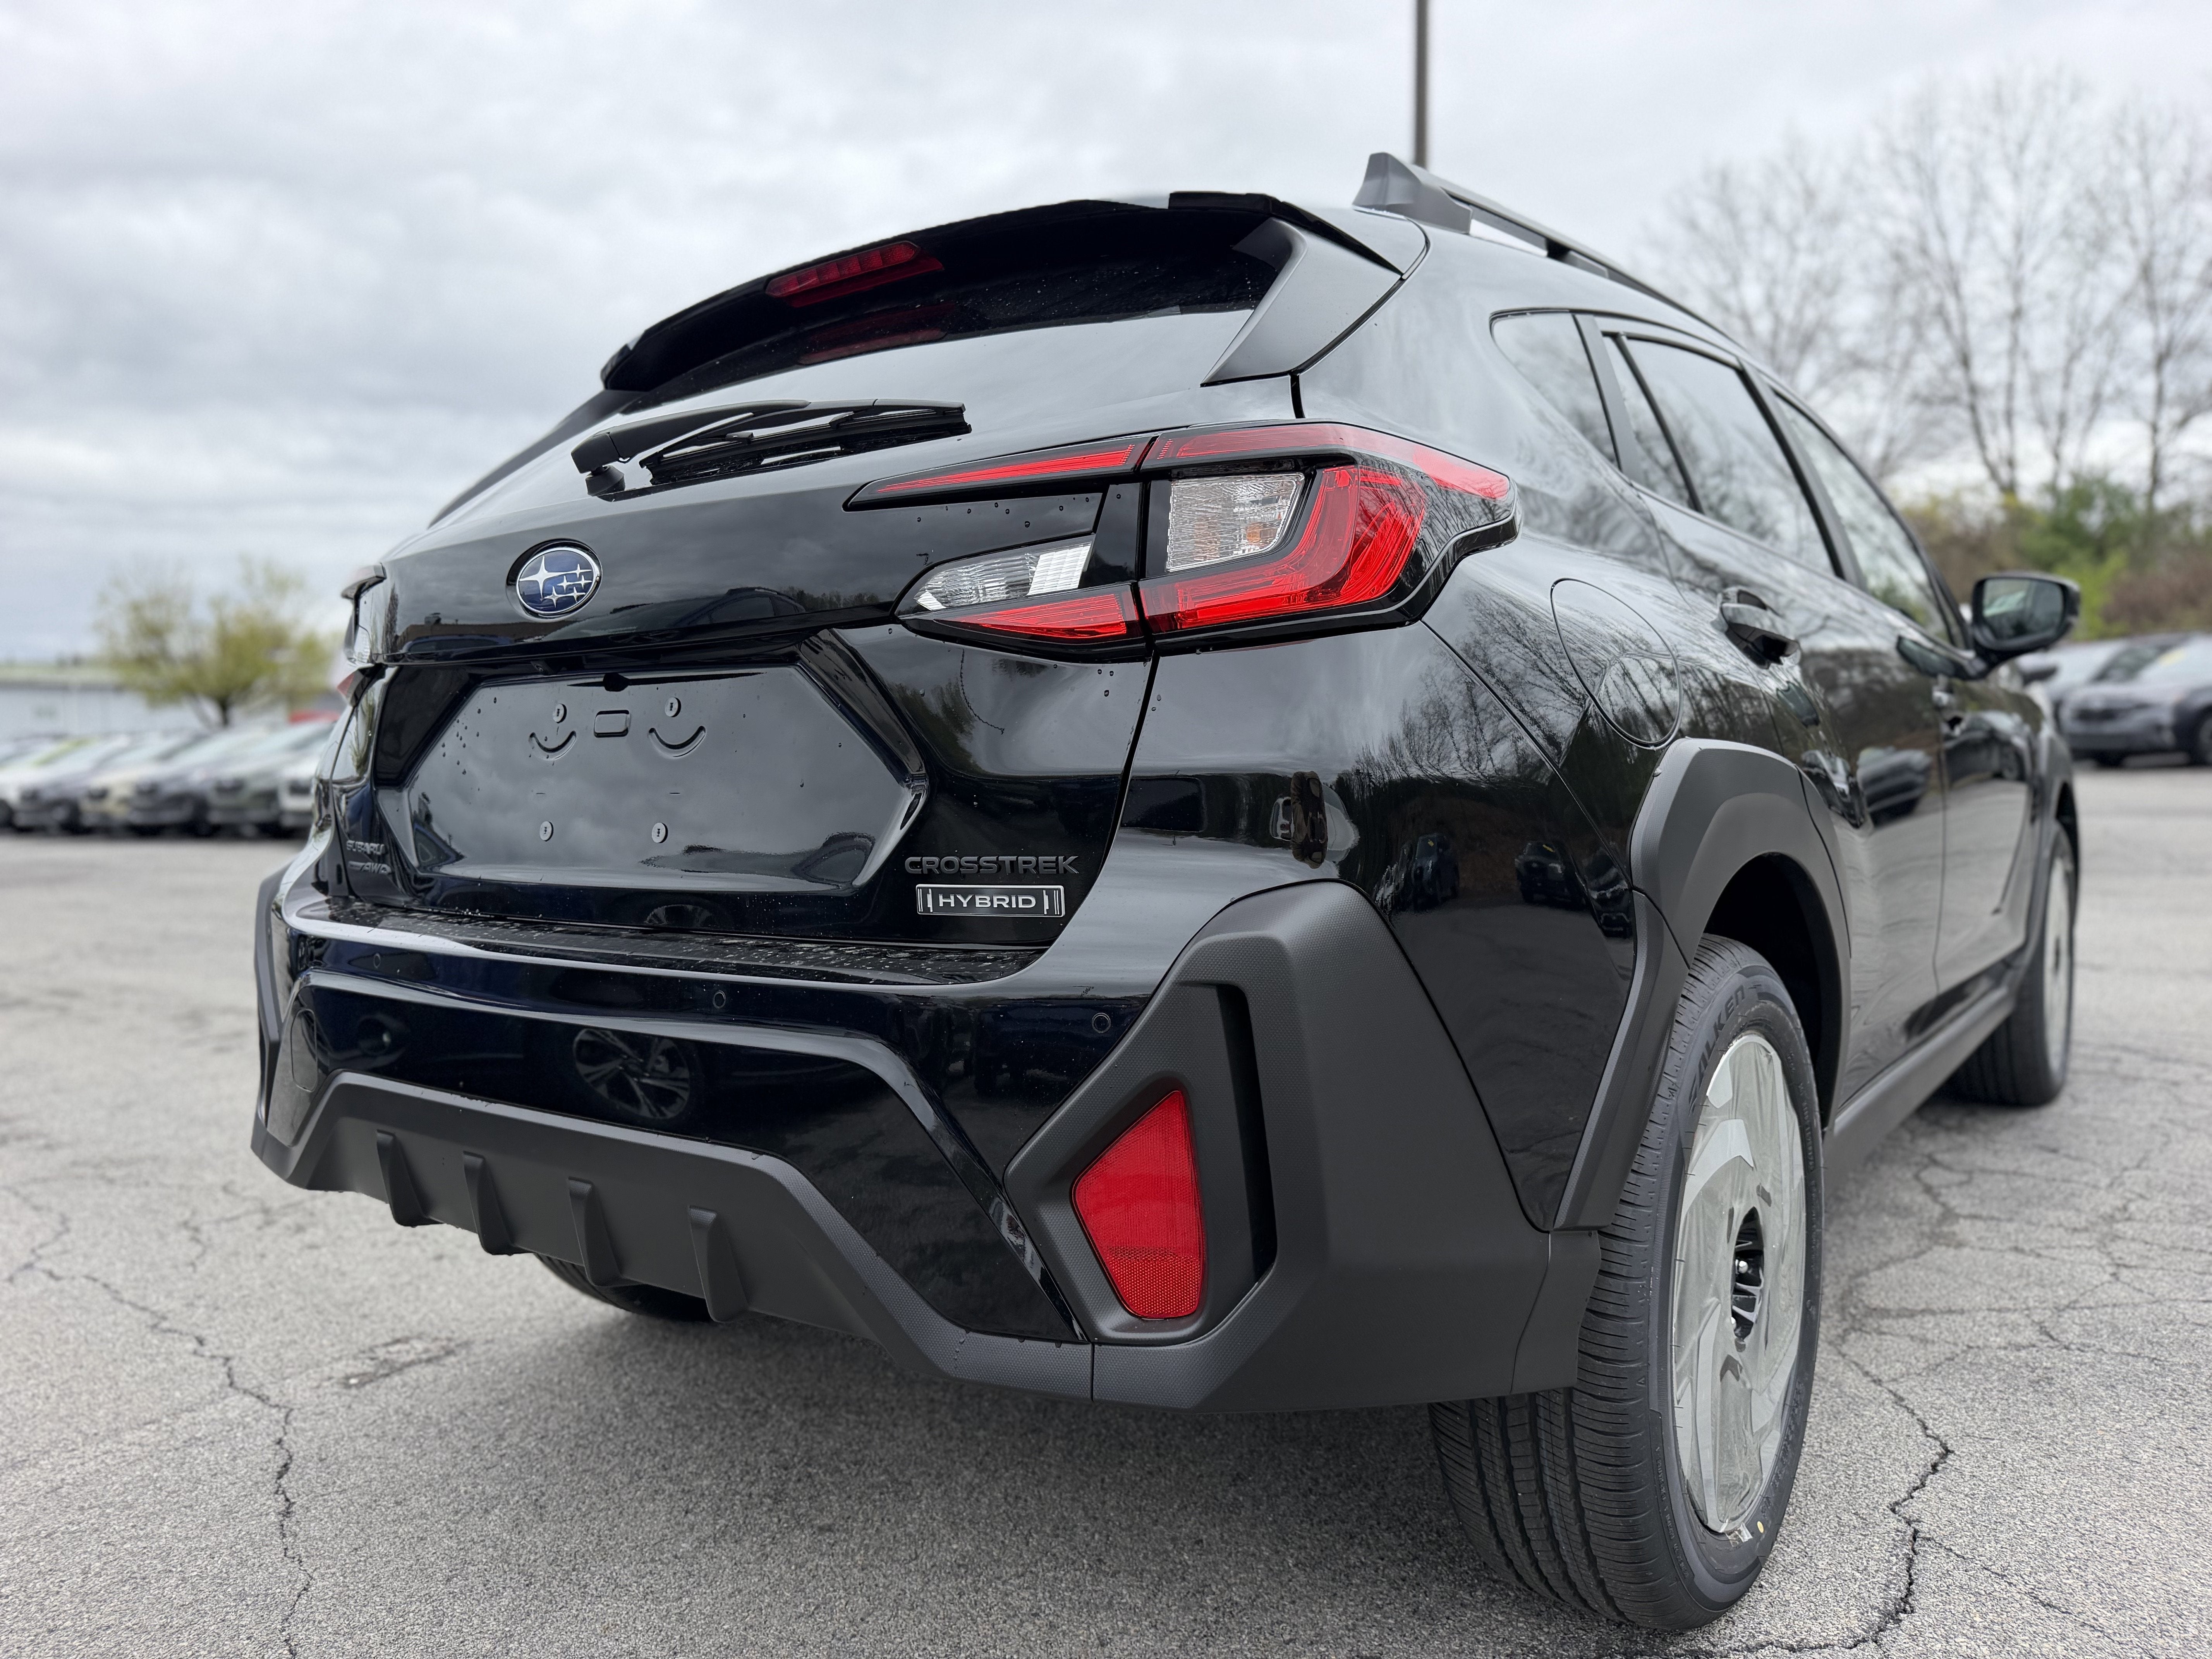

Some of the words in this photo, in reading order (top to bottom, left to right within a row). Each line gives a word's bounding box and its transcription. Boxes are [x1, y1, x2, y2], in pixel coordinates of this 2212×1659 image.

[347, 840, 385, 855] SUBARU
[361, 862, 392, 874] AWD
[905, 855, 1080, 874] CROSSTREK
[938, 893, 1036, 908] HYBRID
